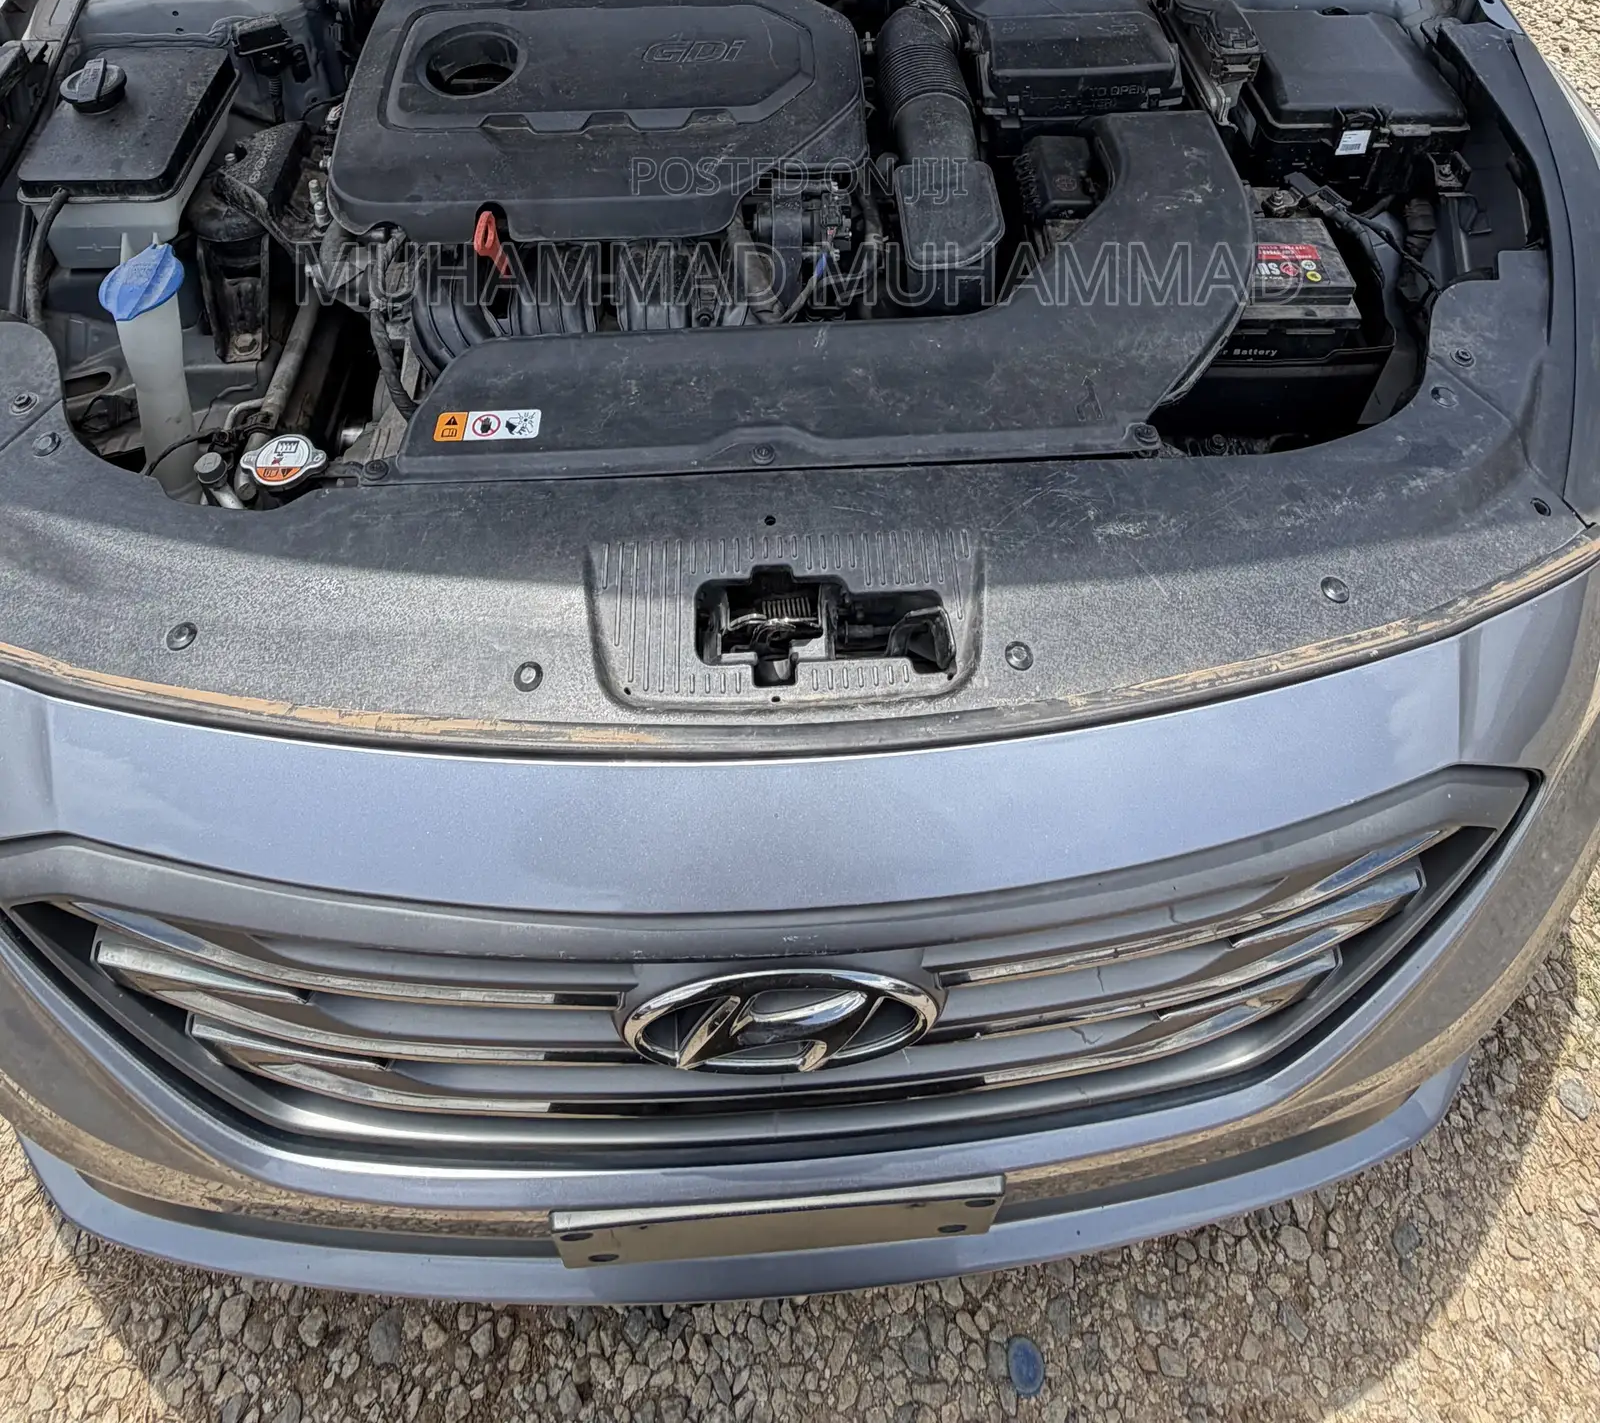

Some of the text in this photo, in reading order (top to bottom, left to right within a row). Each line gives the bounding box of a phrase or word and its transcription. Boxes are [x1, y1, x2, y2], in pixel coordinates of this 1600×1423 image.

[641, 39, 747, 63] GDi
[1110, 84, 1147, 96] OPEN
[1233, 348, 1278, 357] Battery
